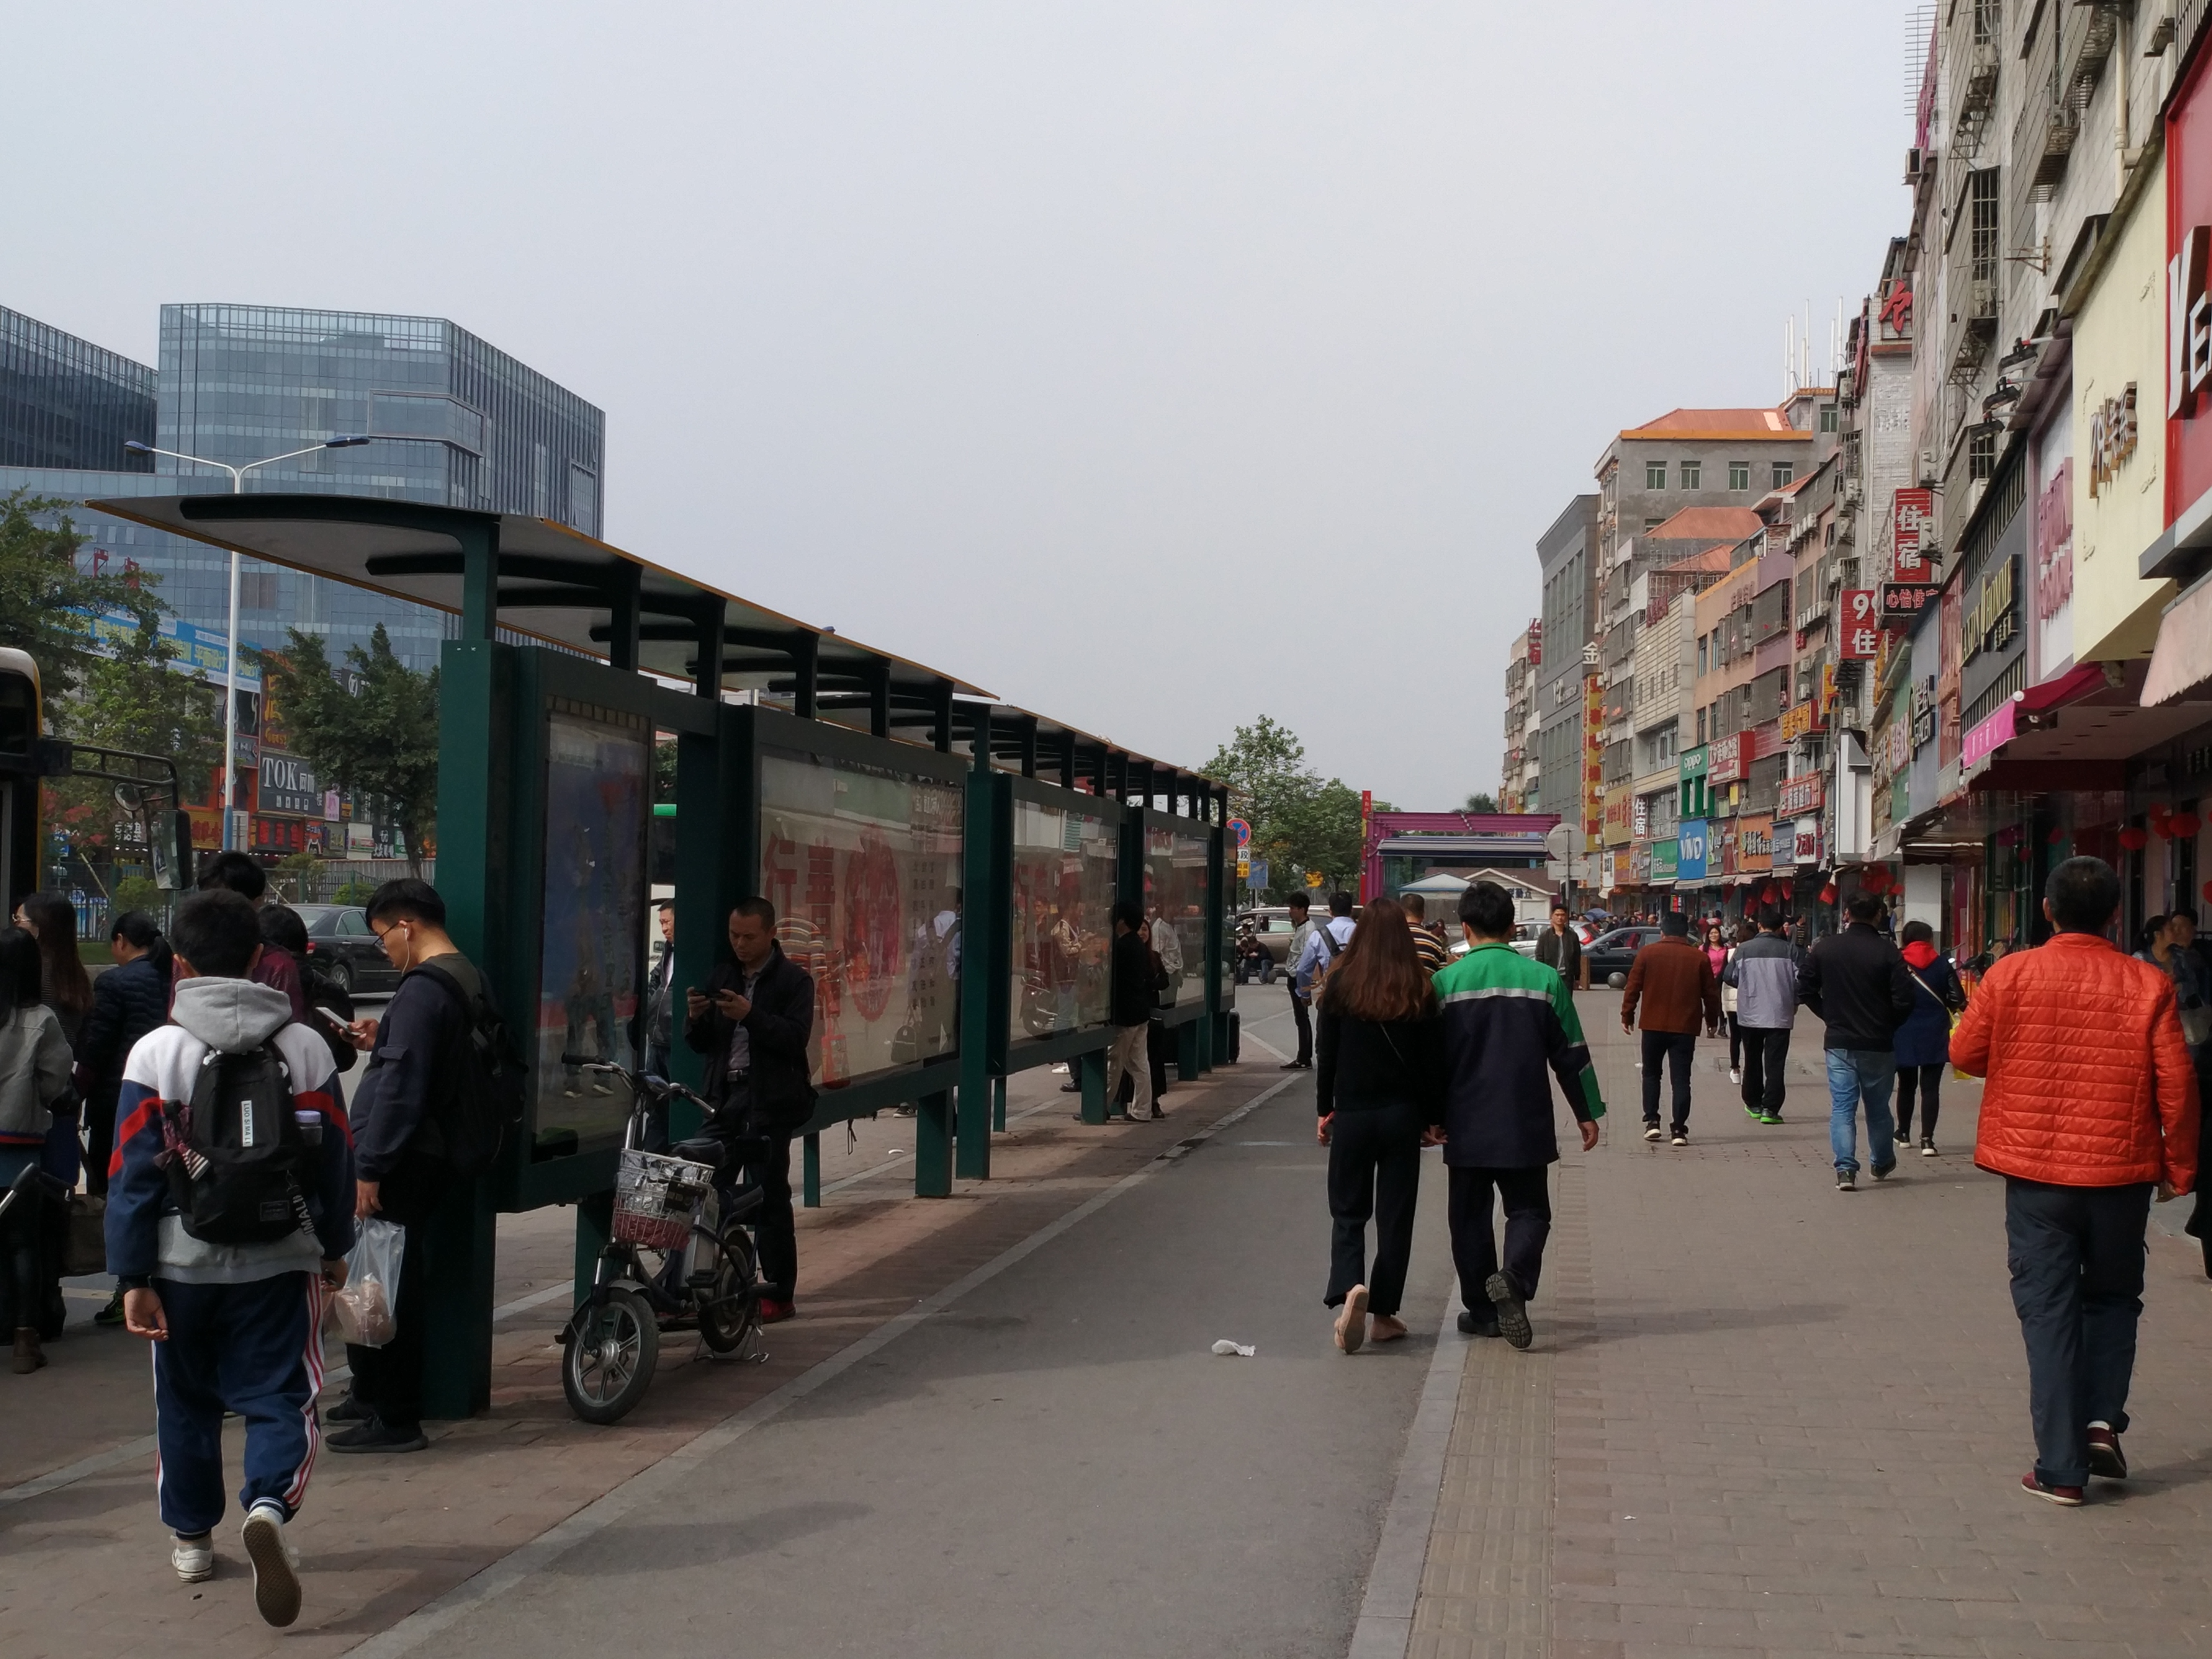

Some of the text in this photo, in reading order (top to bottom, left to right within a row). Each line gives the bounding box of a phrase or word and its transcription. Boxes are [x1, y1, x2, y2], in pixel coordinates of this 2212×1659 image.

[2167, 225, 2212, 419] YE
[1897, 505, 1923, 568] 住宿
[1853, 593, 1876, 621] 9
[1582, 641, 1599, 665] 金
[262, 757, 298, 791] TOK
[1634, 798, 1646, 835] 住宿
